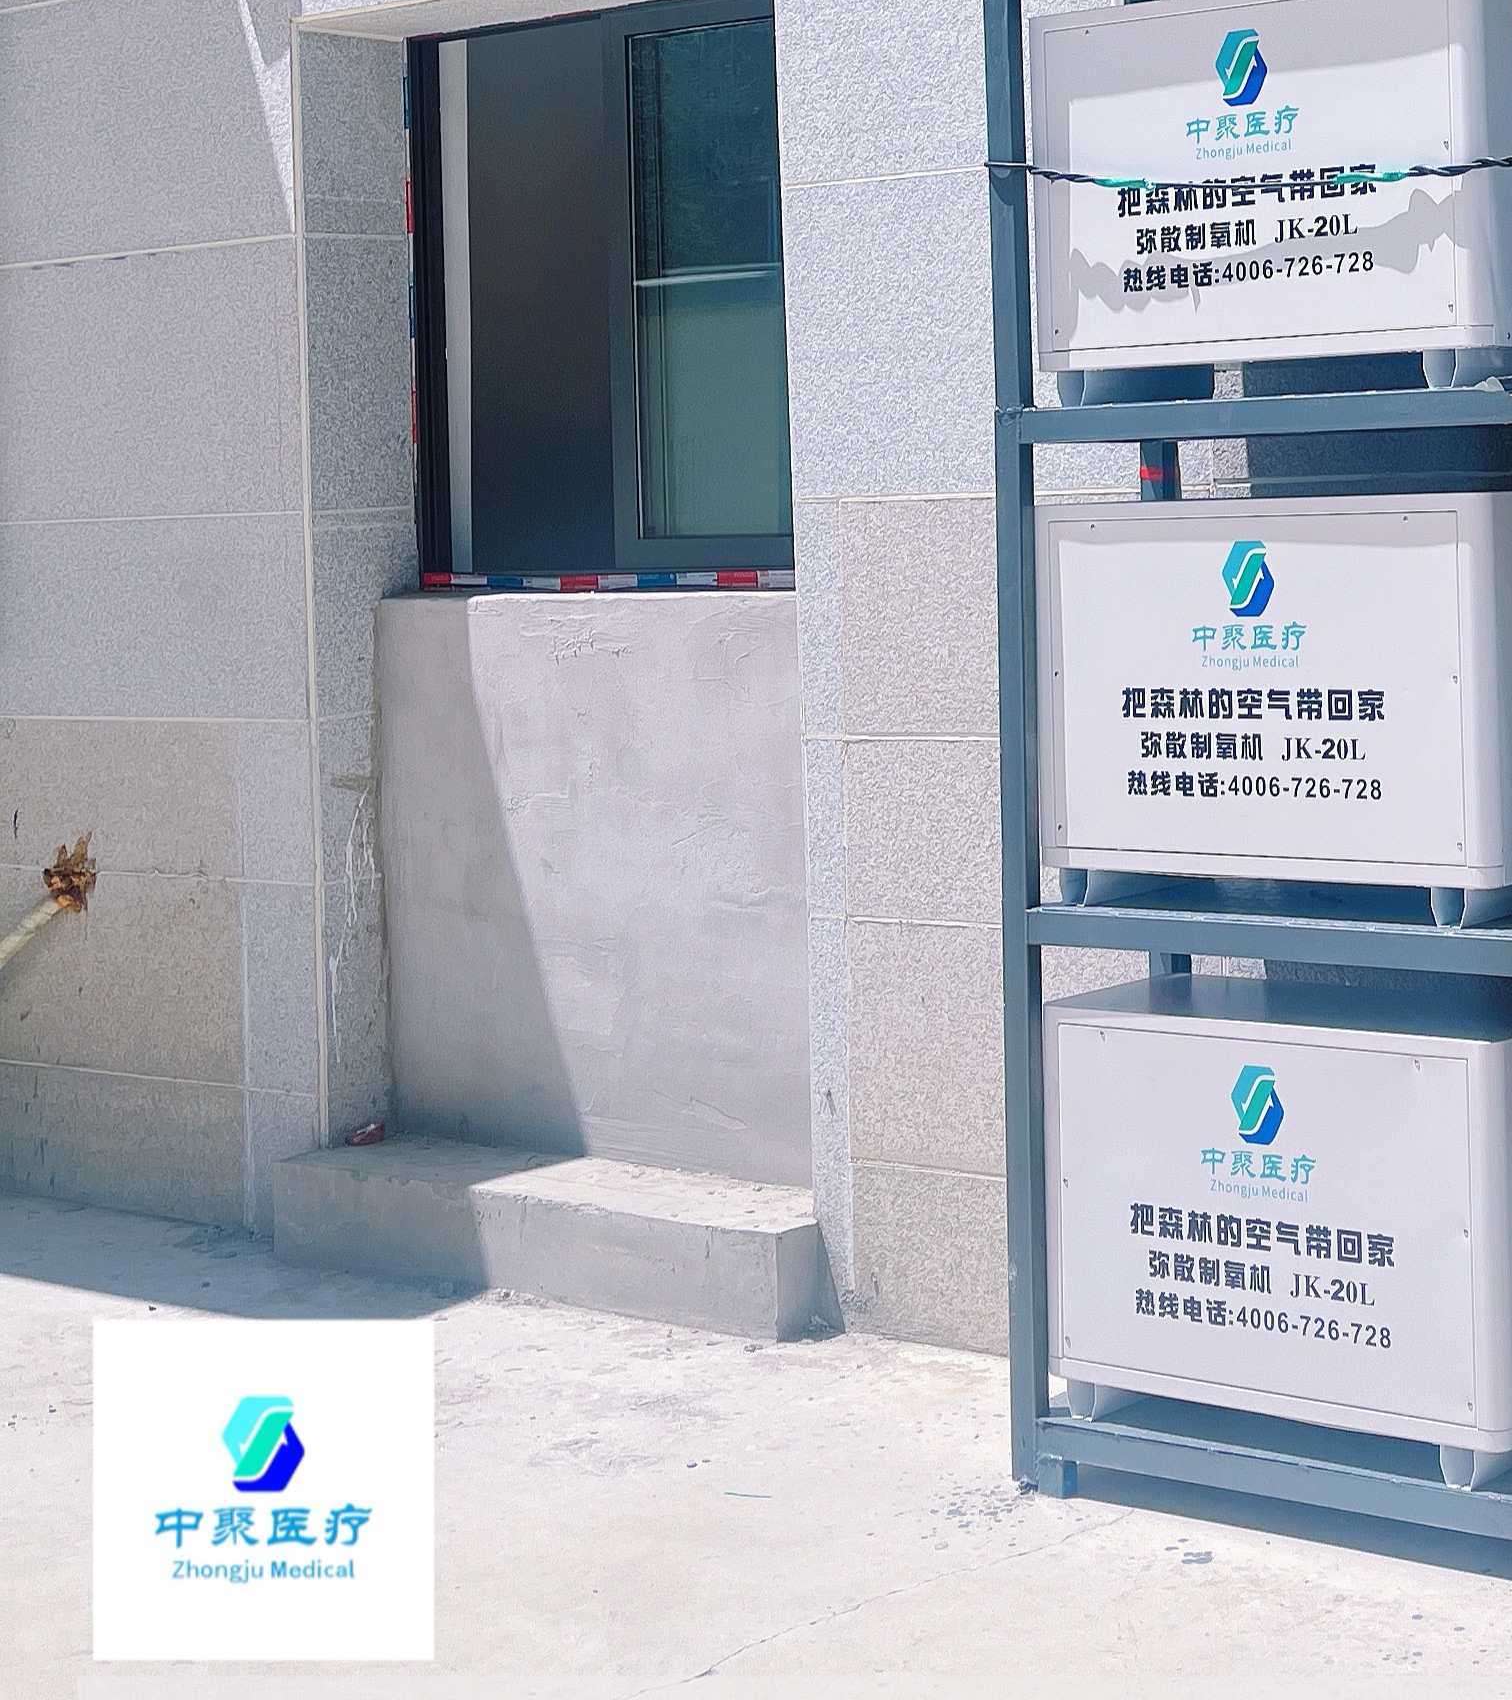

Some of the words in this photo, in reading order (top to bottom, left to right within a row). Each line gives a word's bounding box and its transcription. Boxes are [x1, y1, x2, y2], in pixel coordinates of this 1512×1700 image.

[1185, 104, 1300, 145] 中聚医疗
[1195, 144, 1243, 160] Zhongju
[1245, 138, 1292, 155] Medical
[1136, 218, 1257, 255] 弥散制氧机
[1274, 212, 1359, 244] JK-20L
[1191, 620, 1307, 652] 中聚医疗
[1200, 654, 1250, 672] Zhongju
[1252, 654, 1300, 668] Medical
[1121, 686, 1386, 721] 把森林的空气带回家
[1140, 731, 1264, 761] 弥散制氧机
[1280, 737, 1367, 762] JK-20L
[1200, 1146, 1317, 1185] 中聚医疗
[1209, 1178, 1259, 1199] Zhongju
[1261, 1186, 1309, 1203] Medical
[1129, 1202, 1395, 1268] 把森林的空气带回家
[1148, 1249, 1272, 1295] 弥散制氧机
[1289, 1272, 1376, 1307] JK-20L
